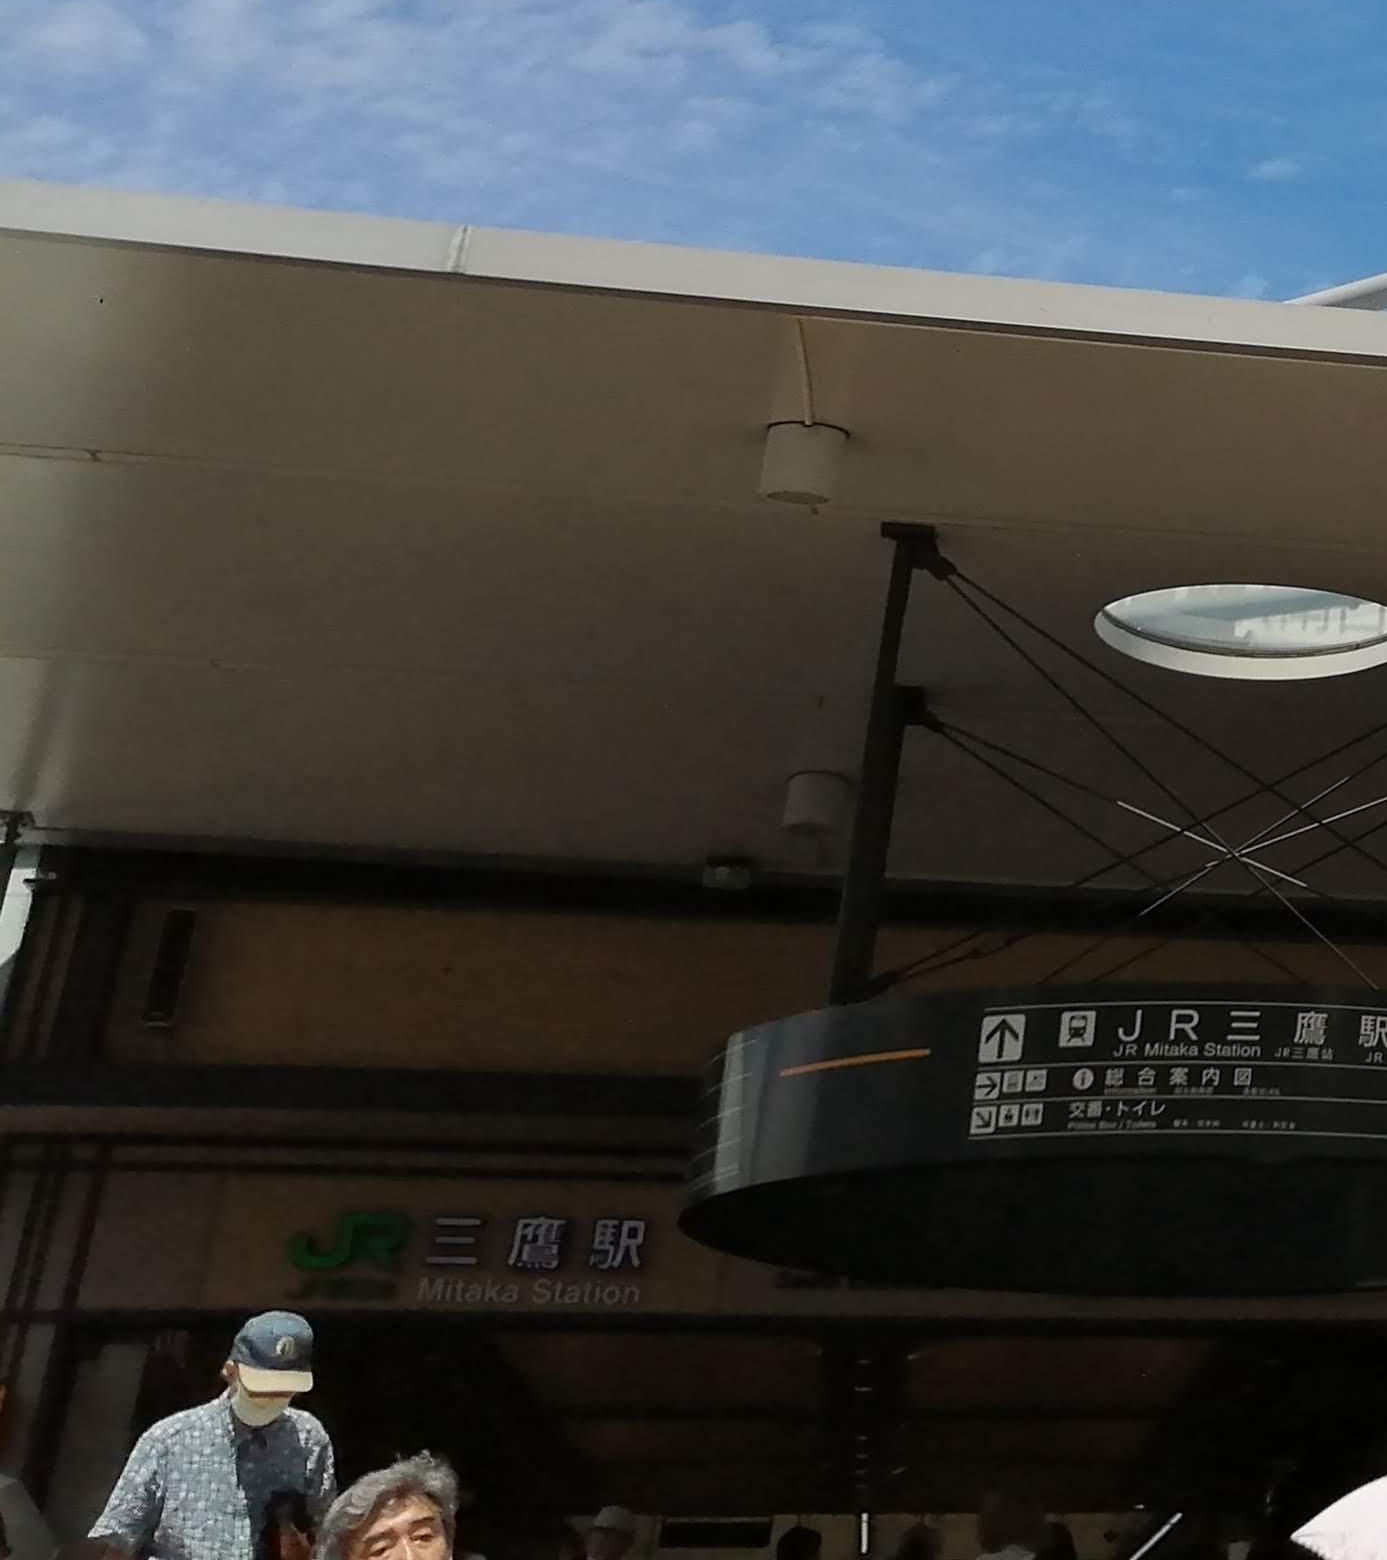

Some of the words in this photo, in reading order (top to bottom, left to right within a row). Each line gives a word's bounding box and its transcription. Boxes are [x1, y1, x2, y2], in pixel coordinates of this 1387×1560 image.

[1112, 1045, 1138, 1057] JR
[1143, 1043, 1199, 1057] Mitaka
[1203, 1042, 1261, 1057] Station
[1366, 1052, 1384, 1064] JR
[426, 1216, 646, 1270] 三鷹駅
[416, 1276, 520, 1305] Mitaka
[531, 1278, 641, 1305] Station
